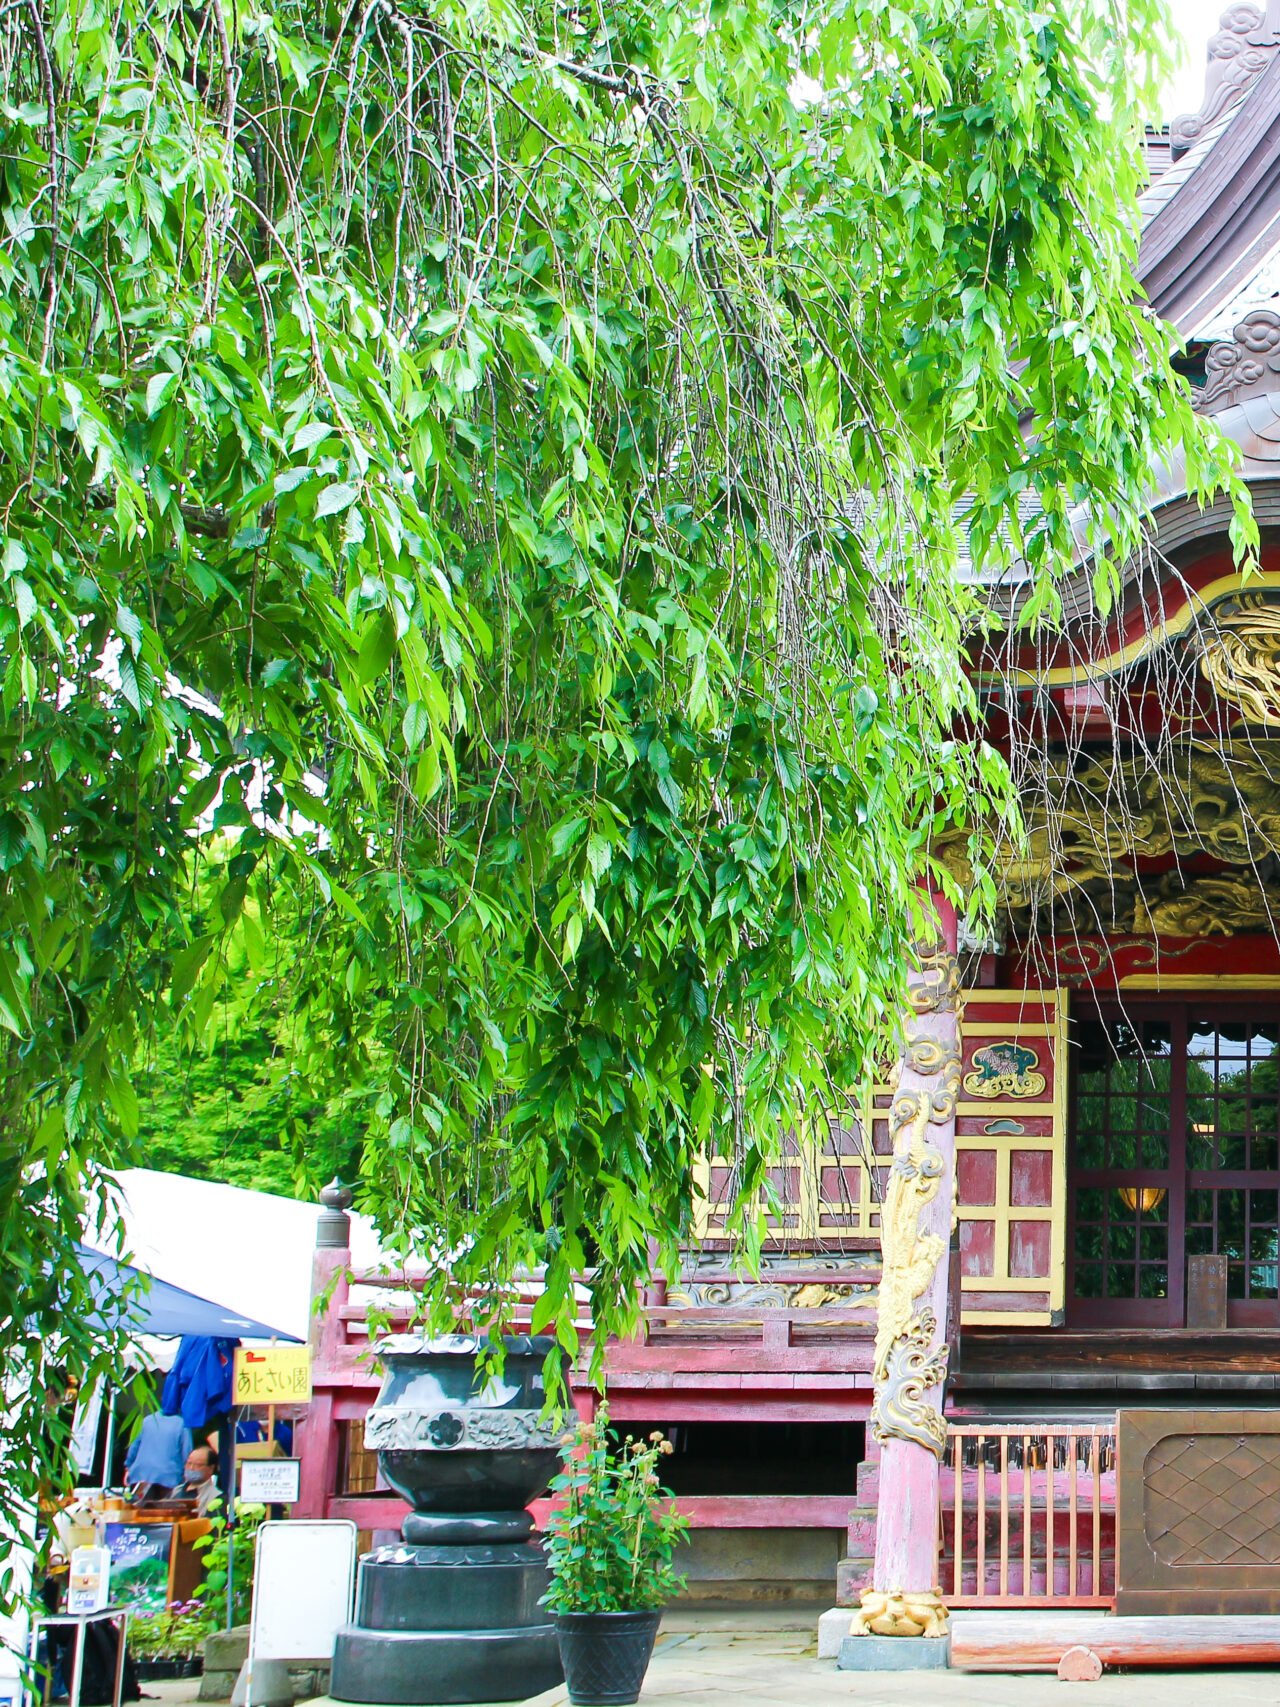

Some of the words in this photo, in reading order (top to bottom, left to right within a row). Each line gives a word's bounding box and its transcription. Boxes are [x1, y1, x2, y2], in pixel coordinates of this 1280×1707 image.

[237, 1367, 308, 1395] あじさい園
[115, 1533, 148, 1545] 水戸の
[104, 1544, 159, 1556] じさいまつり
